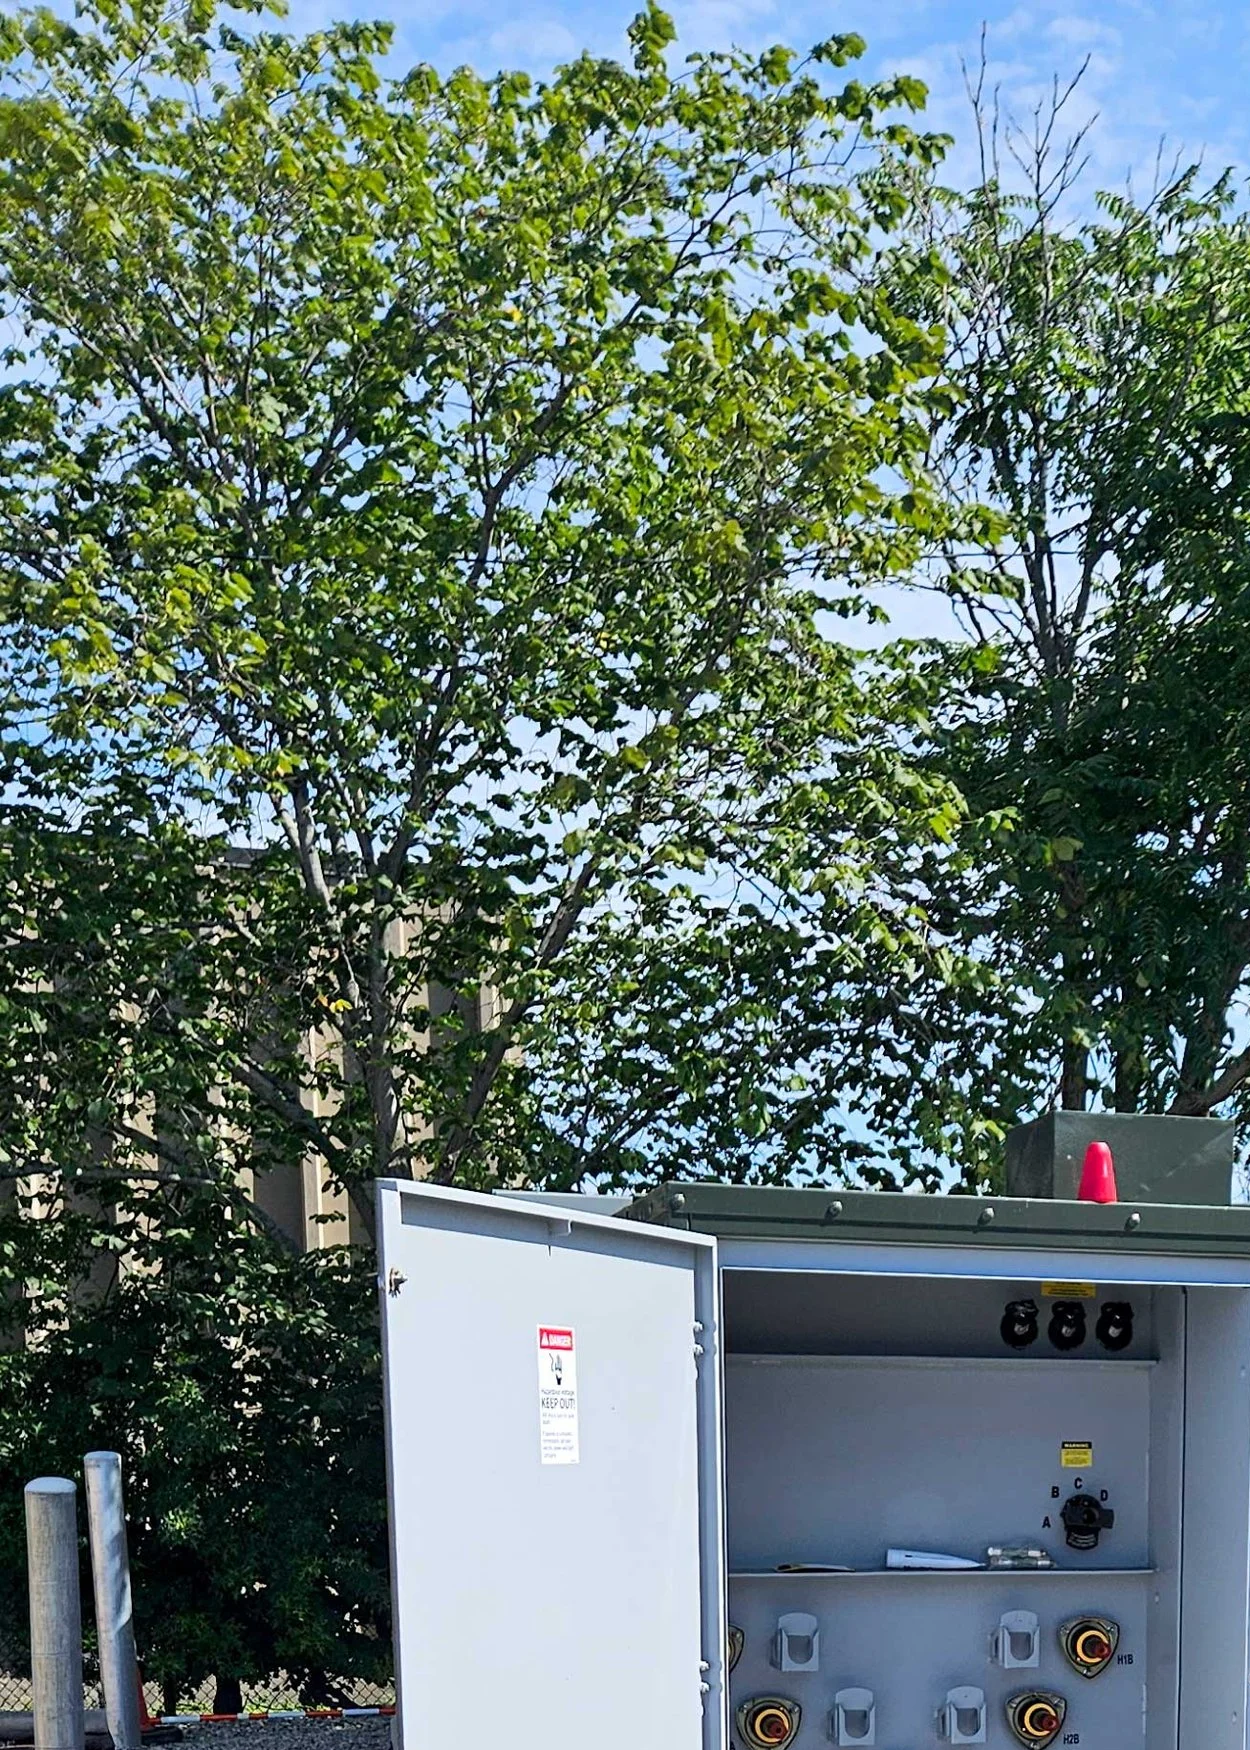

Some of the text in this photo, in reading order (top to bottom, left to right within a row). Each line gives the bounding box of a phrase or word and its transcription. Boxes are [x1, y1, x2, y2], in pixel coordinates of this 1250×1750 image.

[541, 1398, 576, 1409] KEEP OUT!
[1074, 1477, 1083, 1489] C
[1051, 1486, 1060, 1498] B
[1100, 1489, 1108, 1502] D
[1042, 1516, 1051, 1528] A
[1117, 1654, 1134, 1665] H1B
[1063, 1734, 1079, 1744] H2B
